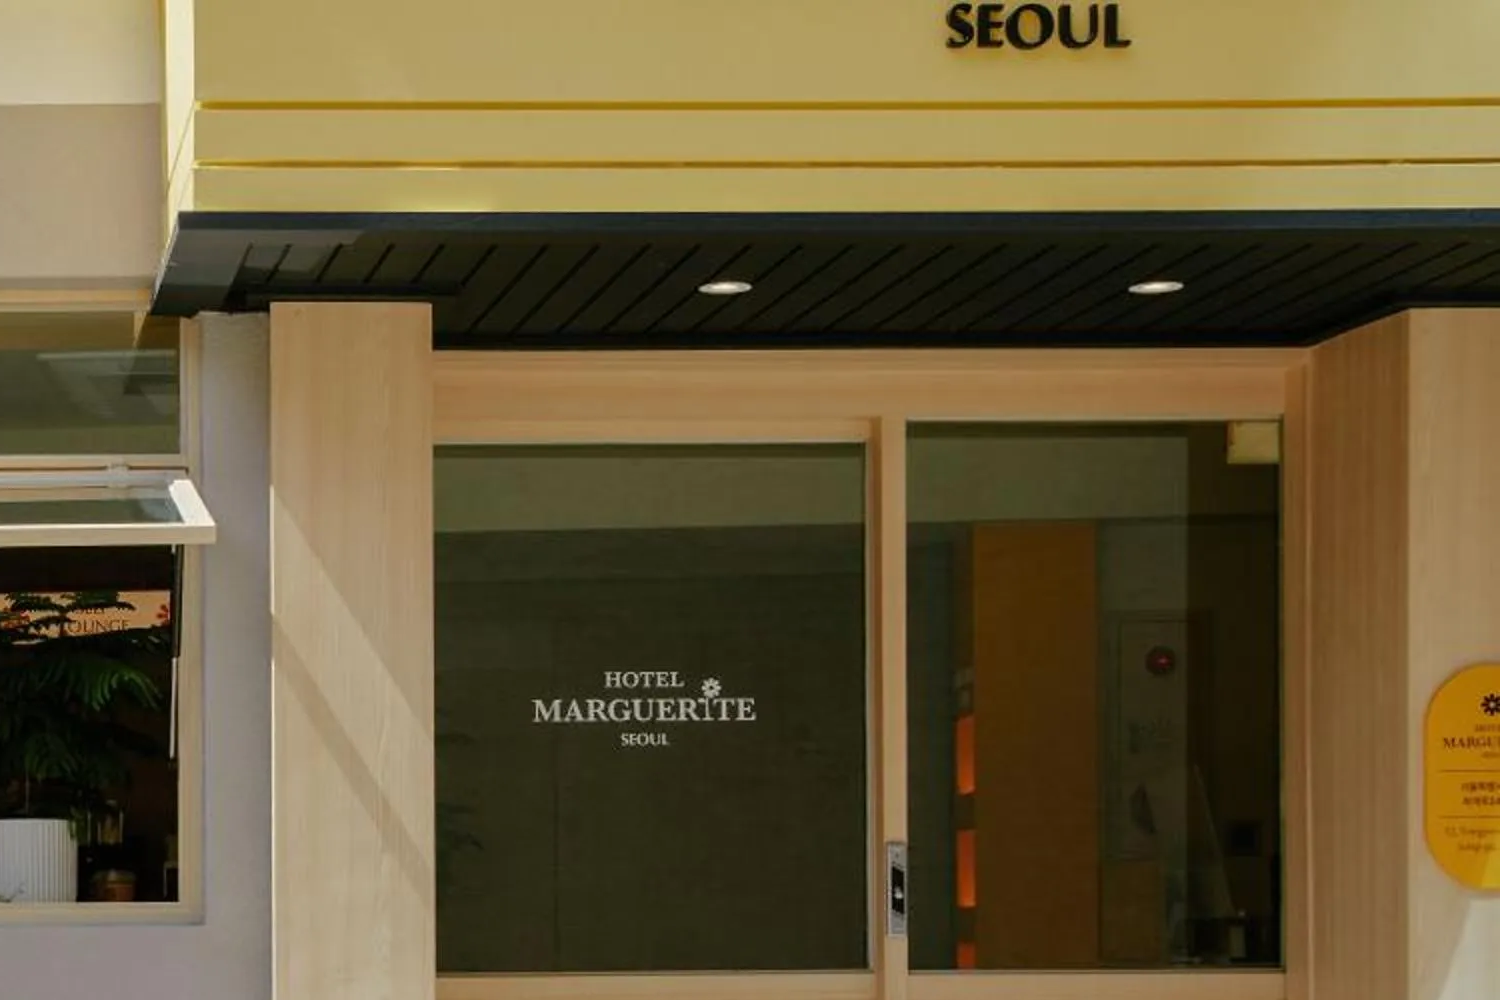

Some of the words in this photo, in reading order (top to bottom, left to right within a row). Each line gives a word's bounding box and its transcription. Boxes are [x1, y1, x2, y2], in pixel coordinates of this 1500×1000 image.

[946, 3, 1132, 49] SEOUL
[605, 672, 684, 688] HOTEL
[533, 698, 756, 722] MARGUERITE
[621, 733, 669, 746] SEOUL
